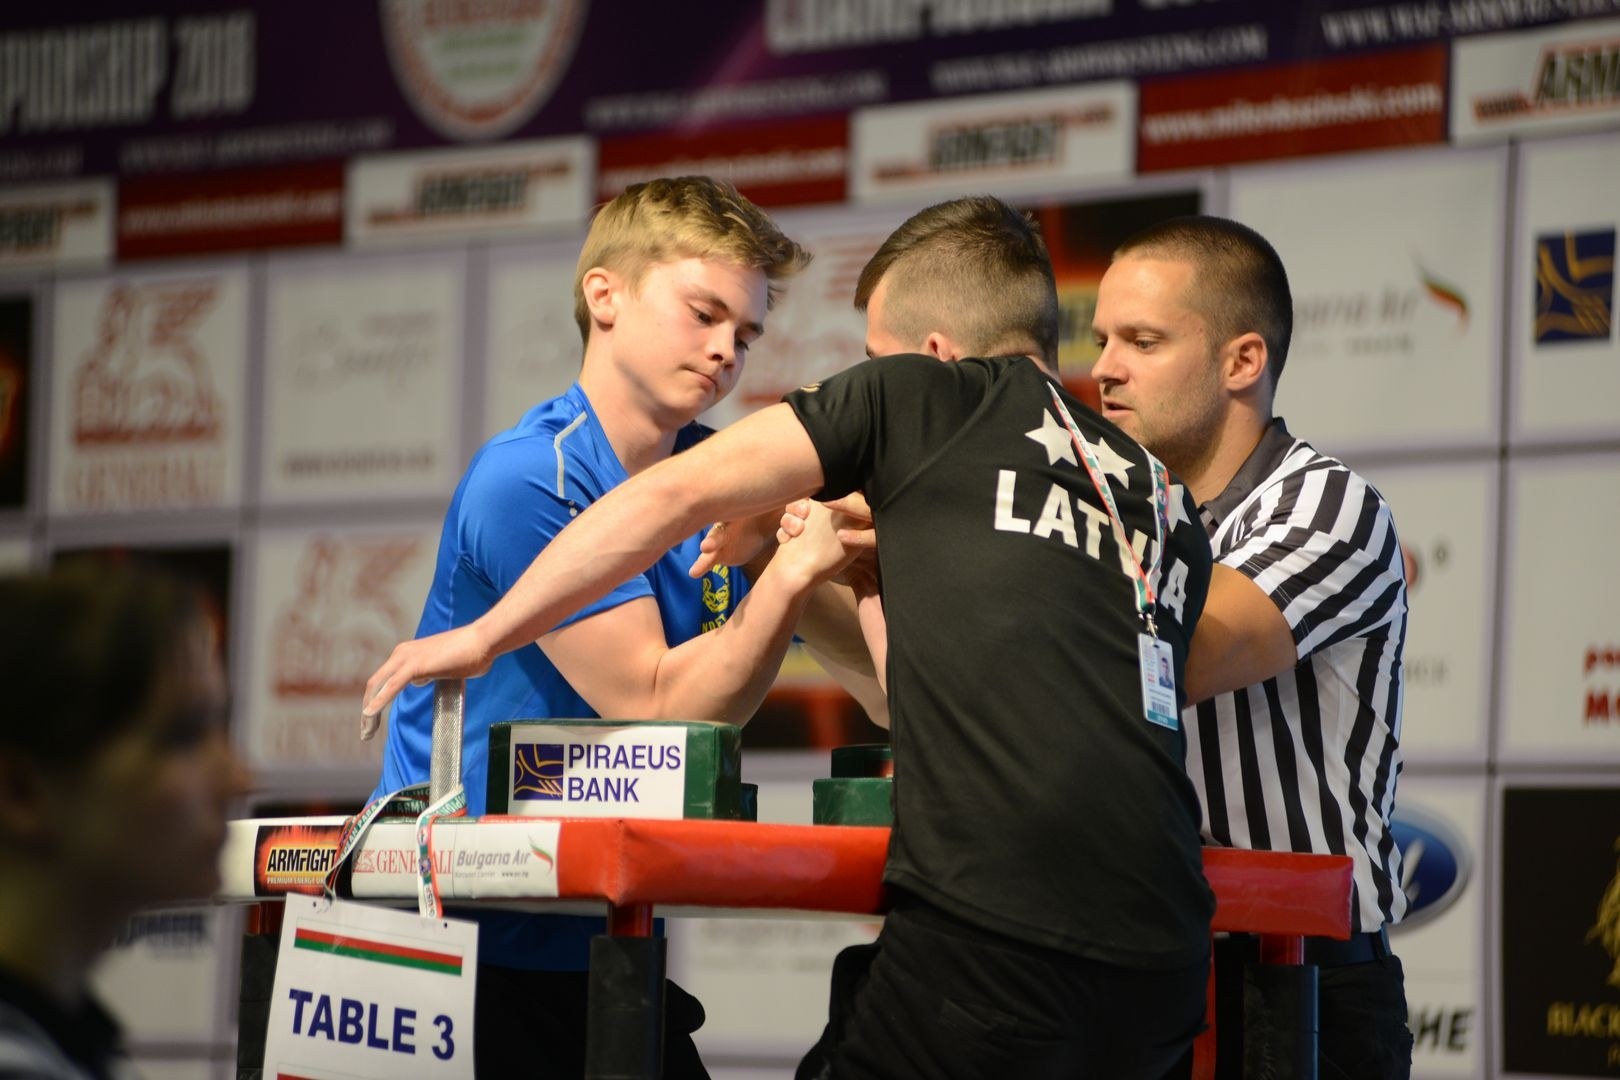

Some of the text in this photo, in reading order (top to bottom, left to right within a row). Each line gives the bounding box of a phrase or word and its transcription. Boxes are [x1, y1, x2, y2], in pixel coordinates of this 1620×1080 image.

[568, 744, 681, 770] PIRAEUS
[567, 777, 640, 803] BANK
[267, 848, 337, 872] ARMFIGHT
[376, 849, 452, 874] GENEALI
[456, 849, 530, 869] Bulgaria Air
[289, 988, 455, 1060] TABLE 3
